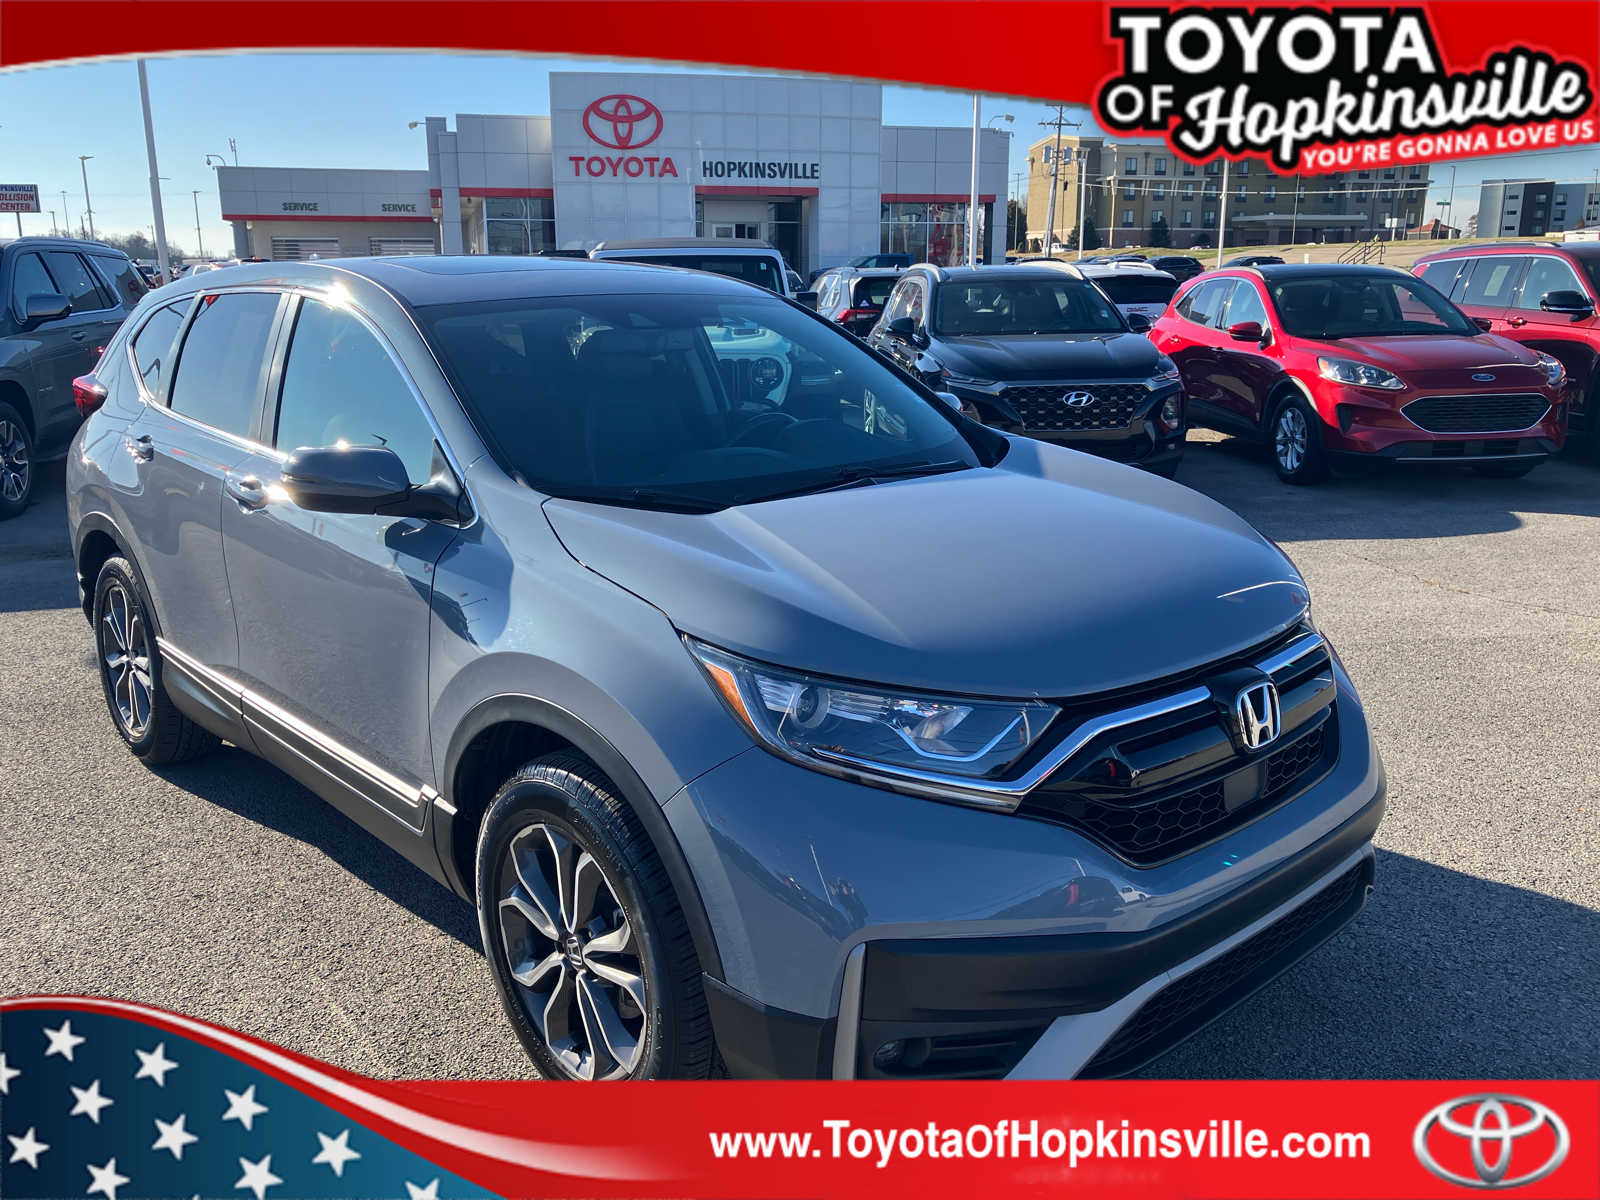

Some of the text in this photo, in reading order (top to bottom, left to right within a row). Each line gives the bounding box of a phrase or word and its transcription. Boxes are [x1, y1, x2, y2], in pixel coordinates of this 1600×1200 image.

[569, 156, 679, 178] TOYOTA
[702, 160, 820, 180] HOPKINSVILLE
[1, 202, 31, 211] CENTER
[282, 202, 319, 212] SERVICE
[381, 203, 417, 213] SERVICE
